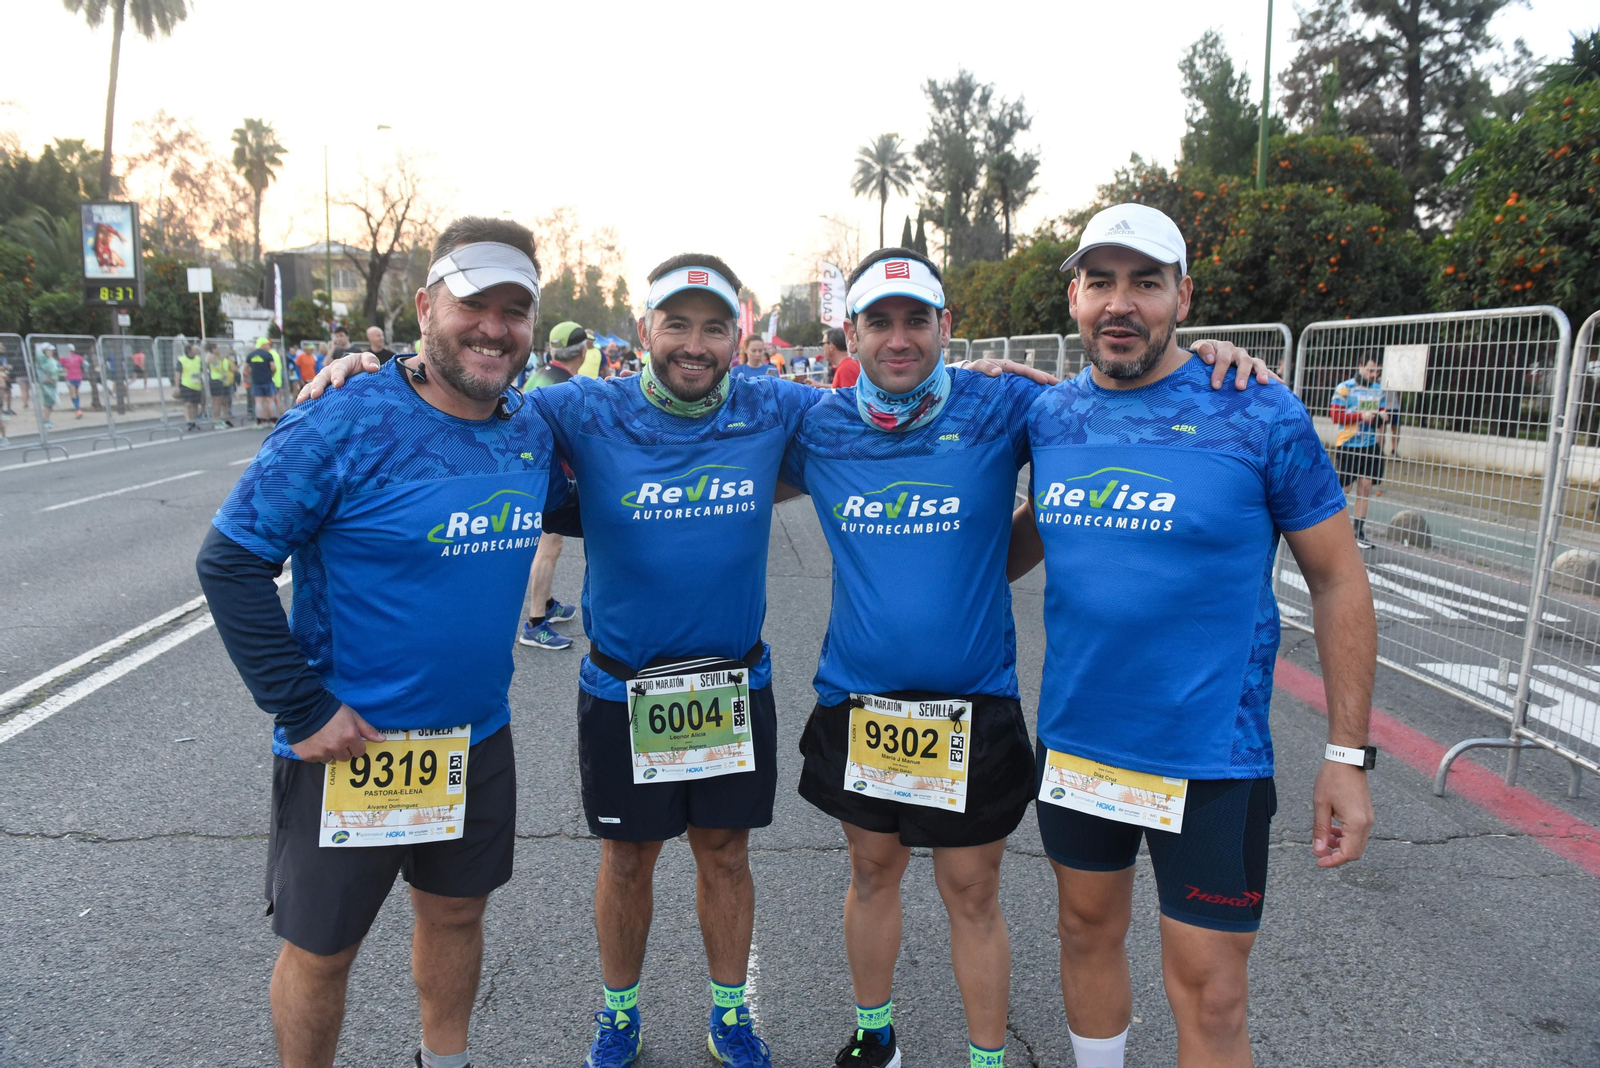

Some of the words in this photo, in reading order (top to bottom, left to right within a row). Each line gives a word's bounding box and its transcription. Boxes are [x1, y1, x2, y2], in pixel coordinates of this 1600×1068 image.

[100, 287, 133, 301] 8:37
[1171, 424, 1197, 432] 42K
[633, 501, 755, 520] AUTORECAMBIOS
[841, 520, 960, 534] AUTORECAMBIOS
[1039, 512, 1173, 531] AUTORECAMBIOS
[440, 536, 540, 557] AUTORECAMBIO
[655, 676, 684, 690] MARATÓN
[700, 671, 733, 688] SEVILLA
[648, 697, 723, 734] 6004
[874, 699, 902, 712] MARATÓN
[919, 703, 953, 717] SEVILLA
[865, 720, 938, 758] 9302
[349, 750, 437, 788] 9319
[685, 766, 703, 774] HOKA
[1105, 775, 1117, 783] Cruz
[364, 788, 423, 796] PASTORA-ELENA
[894, 790, 911, 798] HOKA
[1096, 800, 1116, 812] HOKA
